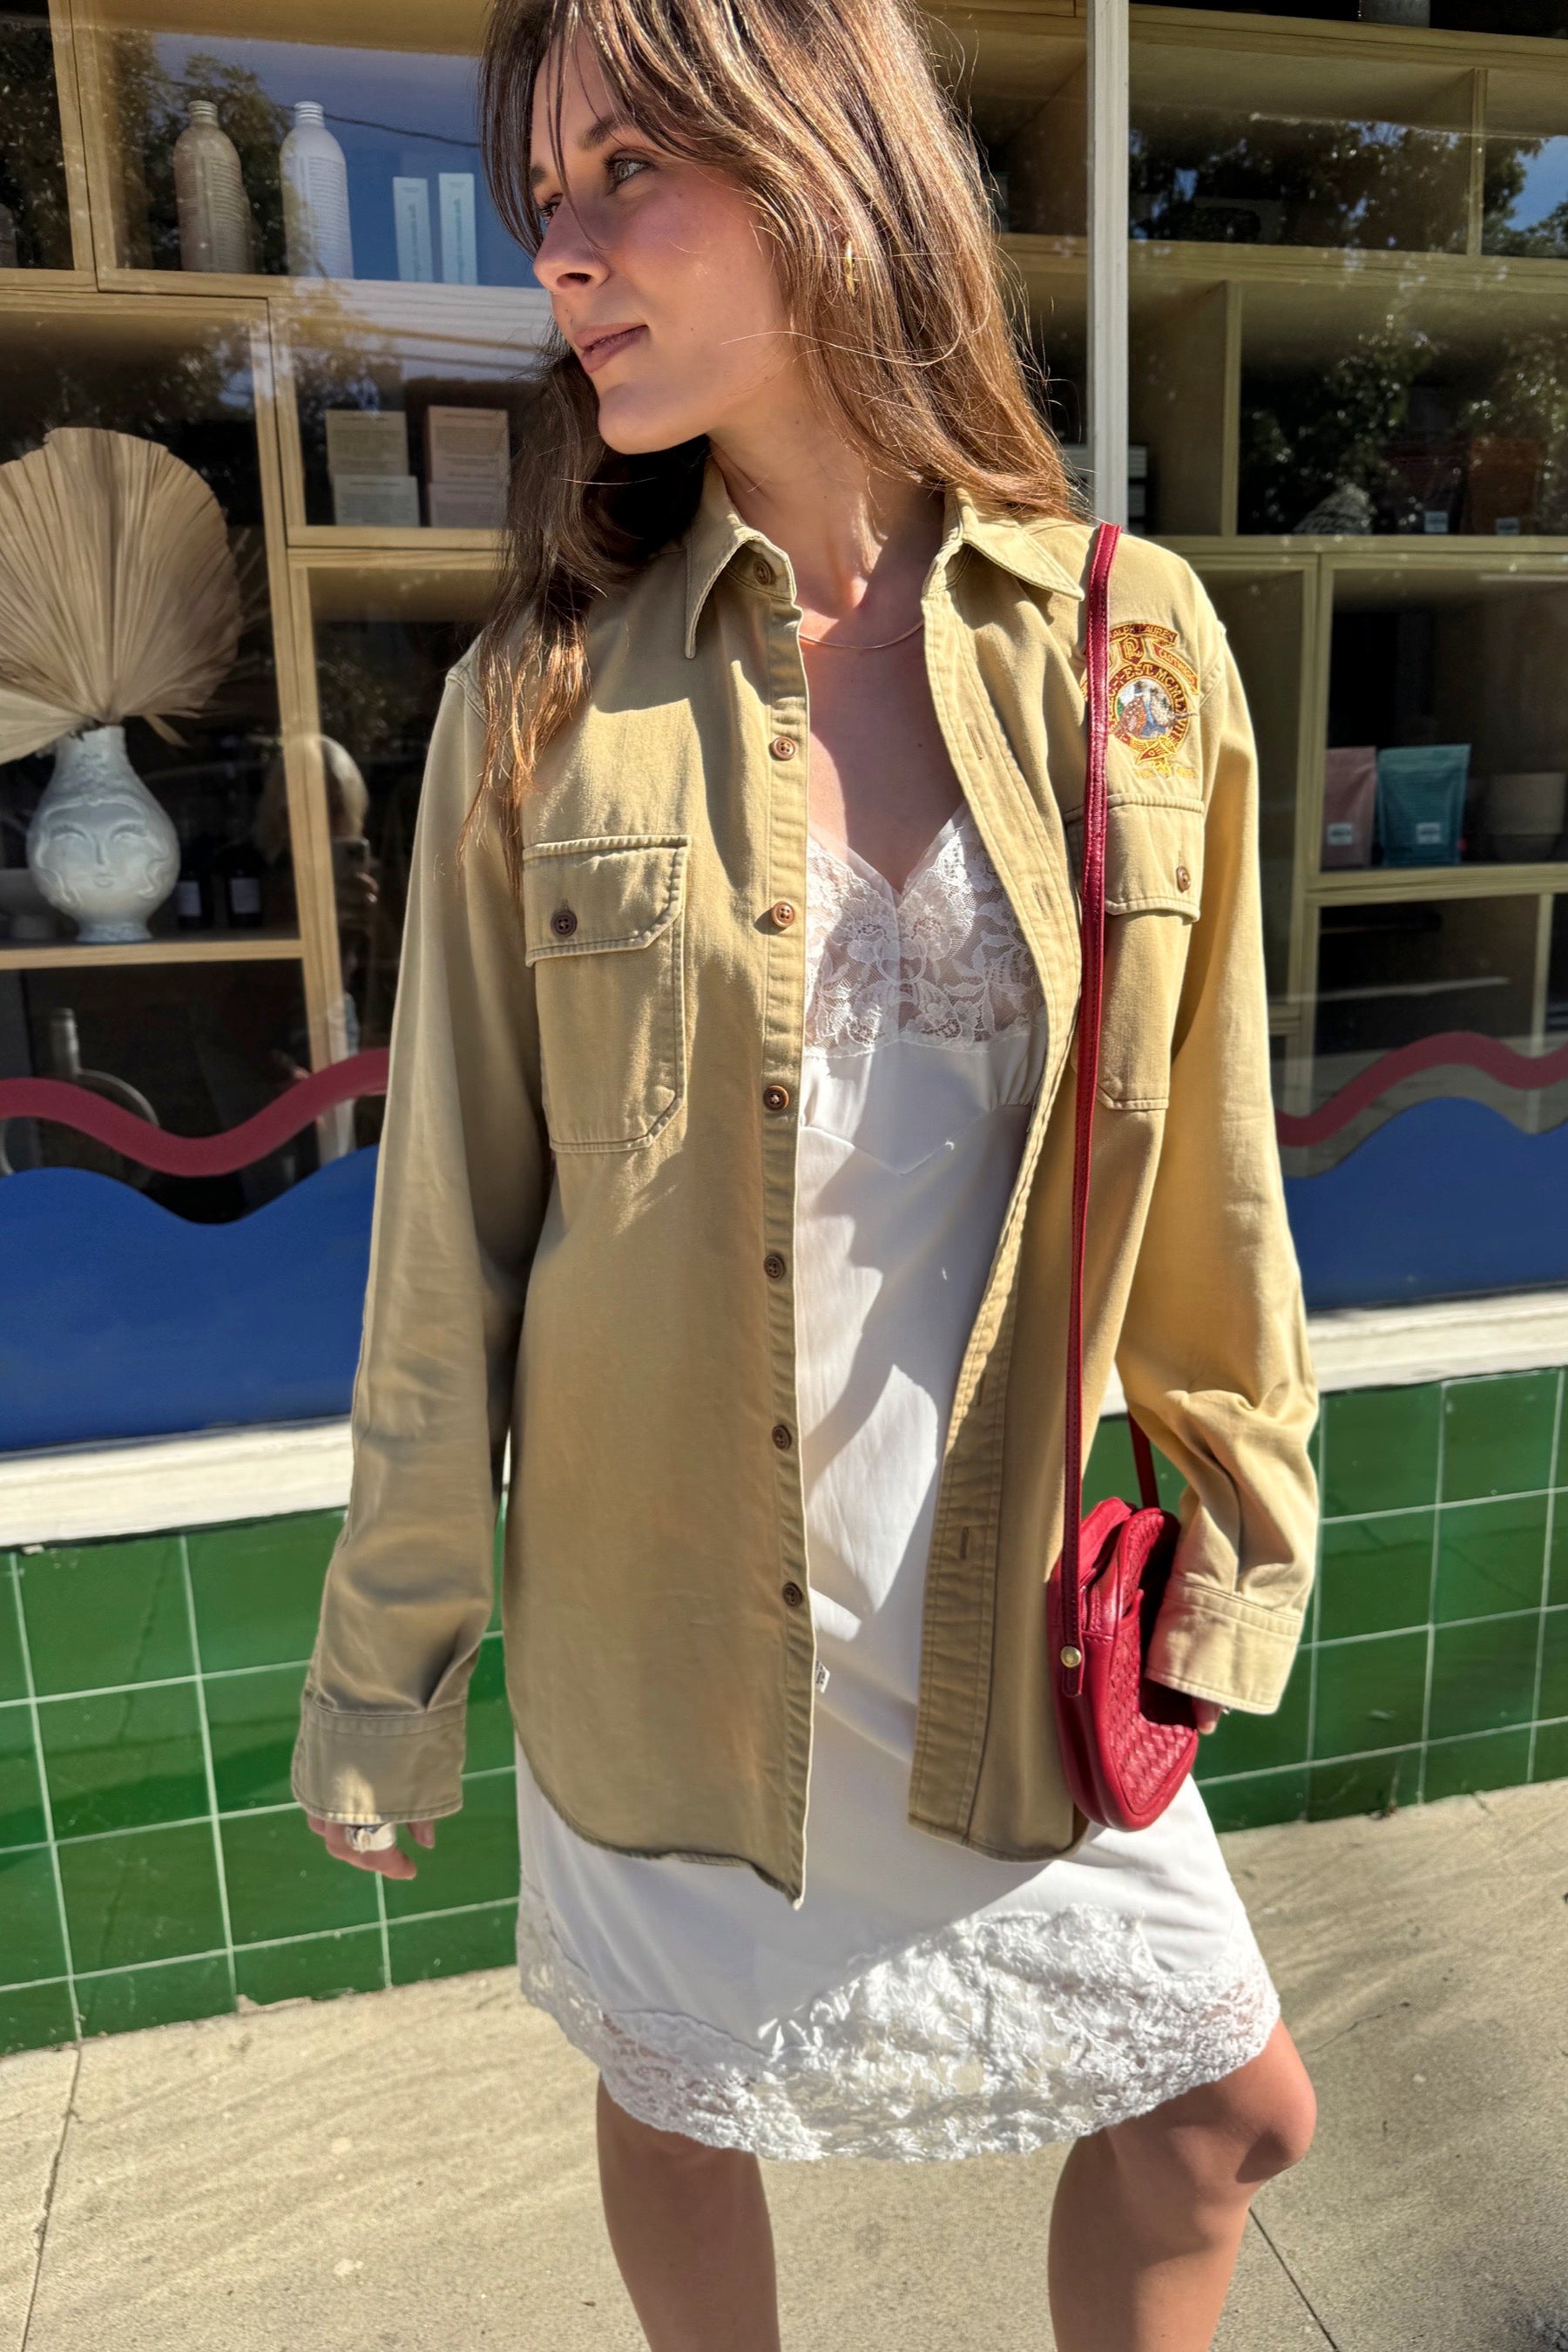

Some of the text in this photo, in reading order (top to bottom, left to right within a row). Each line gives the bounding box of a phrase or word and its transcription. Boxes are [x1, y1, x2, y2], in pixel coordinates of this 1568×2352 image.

[1109, 625, 1175, 641] ALPH LAUREN
[1125, 663, 1154, 678] EST.
